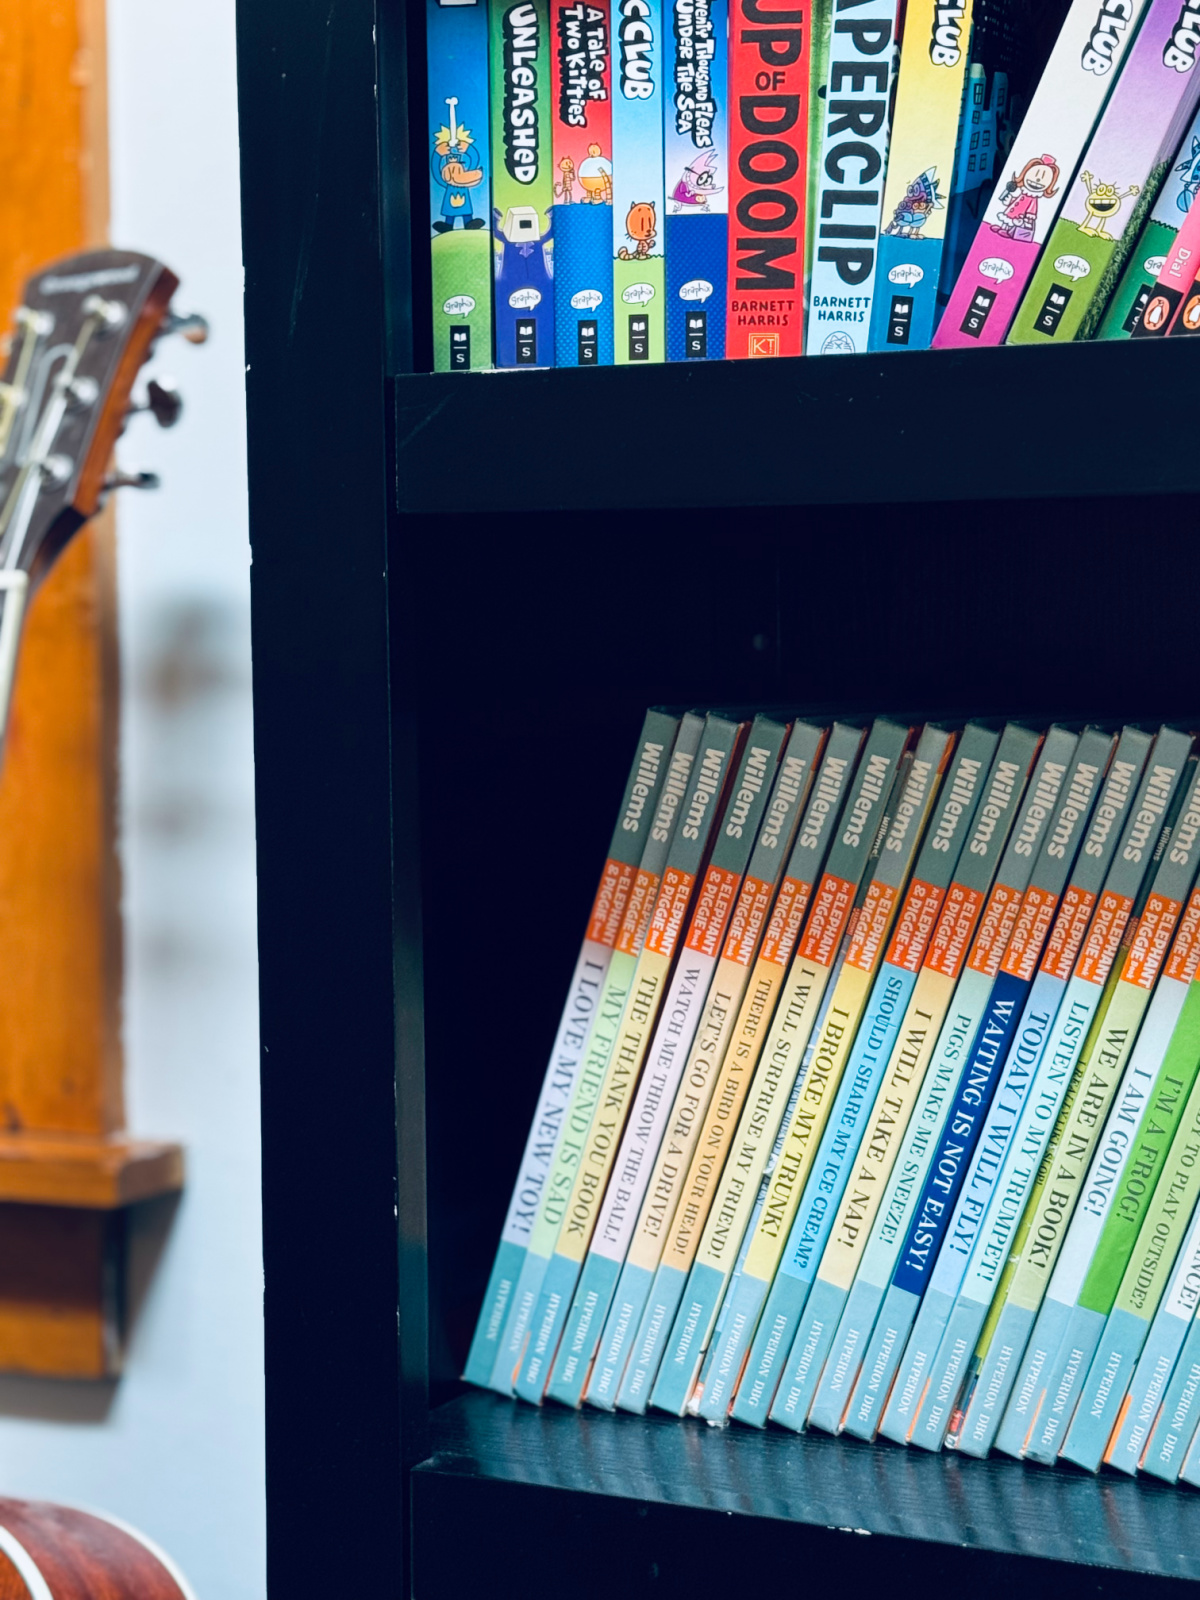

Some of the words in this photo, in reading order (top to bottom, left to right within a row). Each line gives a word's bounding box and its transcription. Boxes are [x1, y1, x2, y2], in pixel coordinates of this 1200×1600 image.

[587, 8, 605, 23] A
[623, 21, 655, 100] CLUB
[755, 71, 786, 91] OF
[817, 0, 894, 286] PERCLIP
[735, 95, 803, 292] DOOM
[890, 266, 923, 281] graphix
[981, 260, 1014, 277] graphix
[1054, 257, 1089, 275] graphix
[1168, 247, 1191, 278] Dial
[444, 299, 475, 314] graphix
[511, 293, 540, 308] graphix
[572, 294, 602, 309] graphix
[623, 285, 655, 302] graphix
[680, 282, 711, 299] graphix
[731, 300, 794, 312] BARNETT
[813, 296, 871, 308] BARNETT
[737, 314, 789, 326] HARRIS
[818, 310, 865, 322] HARRIS
[681, 747, 726, 841] Willems
[725, 746, 771, 840] Willems
[760, 756, 806, 850] Willems
[799, 755, 848, 850] Willems
[841, 753, 890, 849] Willems
[931, 757, 982, 853] Willems
[969, 760, 1020, 857] Willems
[1013, 760, 1066, 858] Willems
[1046, 762, 1098, 860] Willems
[1084, 759, 1136, 859] Willems
[1122, 763, 1176, 864] Willems
[666, 872, 678, 885] &
[682, 874, 691, 885] An
[1028, 891, 1041, 904] &
[1045, 894, 1054, 906] An
[651, 884, 675, 931] PIGGIE
[659, 884, 690, 956] ELEPHANT
[1010, 904, 1037, 953] PIGGIE
[584, 960, 604, 973] I
[1016, 905, 1053, 979] ELEPHANT
[800, 968, 816, 977] I
[563, 977, 599, 1050] LOVE
[599, 983, 627, 1027] MY
[629, 973, 659, 1025] THE
[666, 966, 700, 1036] WATCH
[742, 977, 772, 1038] THERE
[781, 982, 811, 1035] WILL
[831, 1007, 850, 1020] I
[866, 976, 904, 1051] SHOULD
[914, 1009, 933, 1021] I
[656, 1038, 678, 1069] ME
[735, 1040, 752, 1059] IS
[862, 1054, 877, 1064] I
[890, 1026, 927, 1090] WILL
[943, 1014, 972, 1061] PIGS
[961, 996, 1015, 1107] WAITING
[1002, 1009, 1050, 1099] TODAY
[1045, 1000, 1090, 1085] LISTEN
[1096, 1024, 1128, 1069] WE
[550, 1055, 577, 1098] MY
[568, 1033, 613, 1134] FRIEND
[604, 1029, 642, 1113] THANK
[689, 1057, 712, 1089] GO
[730, 1061, 745, 1075] A
[747, 1038, 793, 1138] SURPRISE
[803, 1022, 845, 1106] BROKE
[1132, 1067, 1153, 1080] I
[633, 1071, 668, 1144] THROW
[673, 1094, 701, 1138] FOR
[715, 1077, 740, 1121] BIRD
[840, 1064, 874, 1128] SHARE
[921, 1063, 955, 1123] MAKE
[997, 1102, 1018, 1116] I
[1033, 1088, 1059, 1121] TO
[1075, 1072, 1112, 1129] ARE
[1116, 1082, 1147, 1124] AM
[530, 1101, 564, 1167] NEW
[588, 1119, 616, 1167] YOU
[706, 1124, 725, 1149] ON
[789, 1107, 817, 1147] MY
[830, 1129, 852, 1159] MY
[865, 1094, 904, 1163] TAKE
[909, 1126, 933, 1158] ME
[951, 1110, 976, 1138] IS
[1018, 1125, 1046, 1164] MY
[1064, 1132, 1091, 1162] IN
[1146, 1119, 1168, 1138] A
[559, 1139, 583, 1167] IS
[620, 1145, 645, 1185] THE
[667, 1143, 686, 1159] A
[690, 1152, 716, 1198] YOUR
[735, 1142, 758, 1174] MY
[858, 1166, 879, 1185] A
[931, 1142, 965, 1195] NOT
[970, 1121, 1012, 1193] WILL
[1056, 1165, 1079, 1184] A
[1083, 1128, 1131, 1217] GOING!
[1179, 1142, 1200, 1168] TO
[512, 1170, 545, 1234] TOY!
[542, 1171, 574, 1226] SAD
[642, 1162, 680, 1238] DRIVE!
[759, 1149, 804, 1239] TRUNK!
[818, 1162, 841, 1193] ICE
[1115, 1144, 1159, 1223] FROG!
[1161, 1171, 1190, 1220] PLAY
[566, 1170, 601, 1239] BOOK
[602, 1187, 632, 1243] BALL!
[706, 1177, 746, 1260] FRIEND!
[836, 1189, 872, 1249] NAP!
[878, 1160, 921, 1245] SNEEZE!
[948, 1196, 985, 1256] FLY!
[976, 1165, 1032, 1282] TRUMPET!
[672, 1202, 700, 1255] HEAD!
[792, 1195, 829, 1269] CREAM?
[904, 1196, 946, 1272] EASY!
[1027, 1188, 1071, 1269] BOOK!
[1128, 1222, 1172, 1309] OUTSIDE?
[534, 1293, 561, 1355] HYPERION
[638, 1304, 666, 1366] HYPERION
[526, 1357, 542, 1384] DBG
[794, 1320, 824, 1384] HYPERION
[936, 1338, 967, 1402] HYPERION
[629, 1369, 646, 1395] DBG
[784, 1386, 802, 1414] DBG
[982, 1345, 1013, 1410] HYPERION
[925, 1405, 944, 1433] DBG
[972, 1413, 990, 1441] DBG
